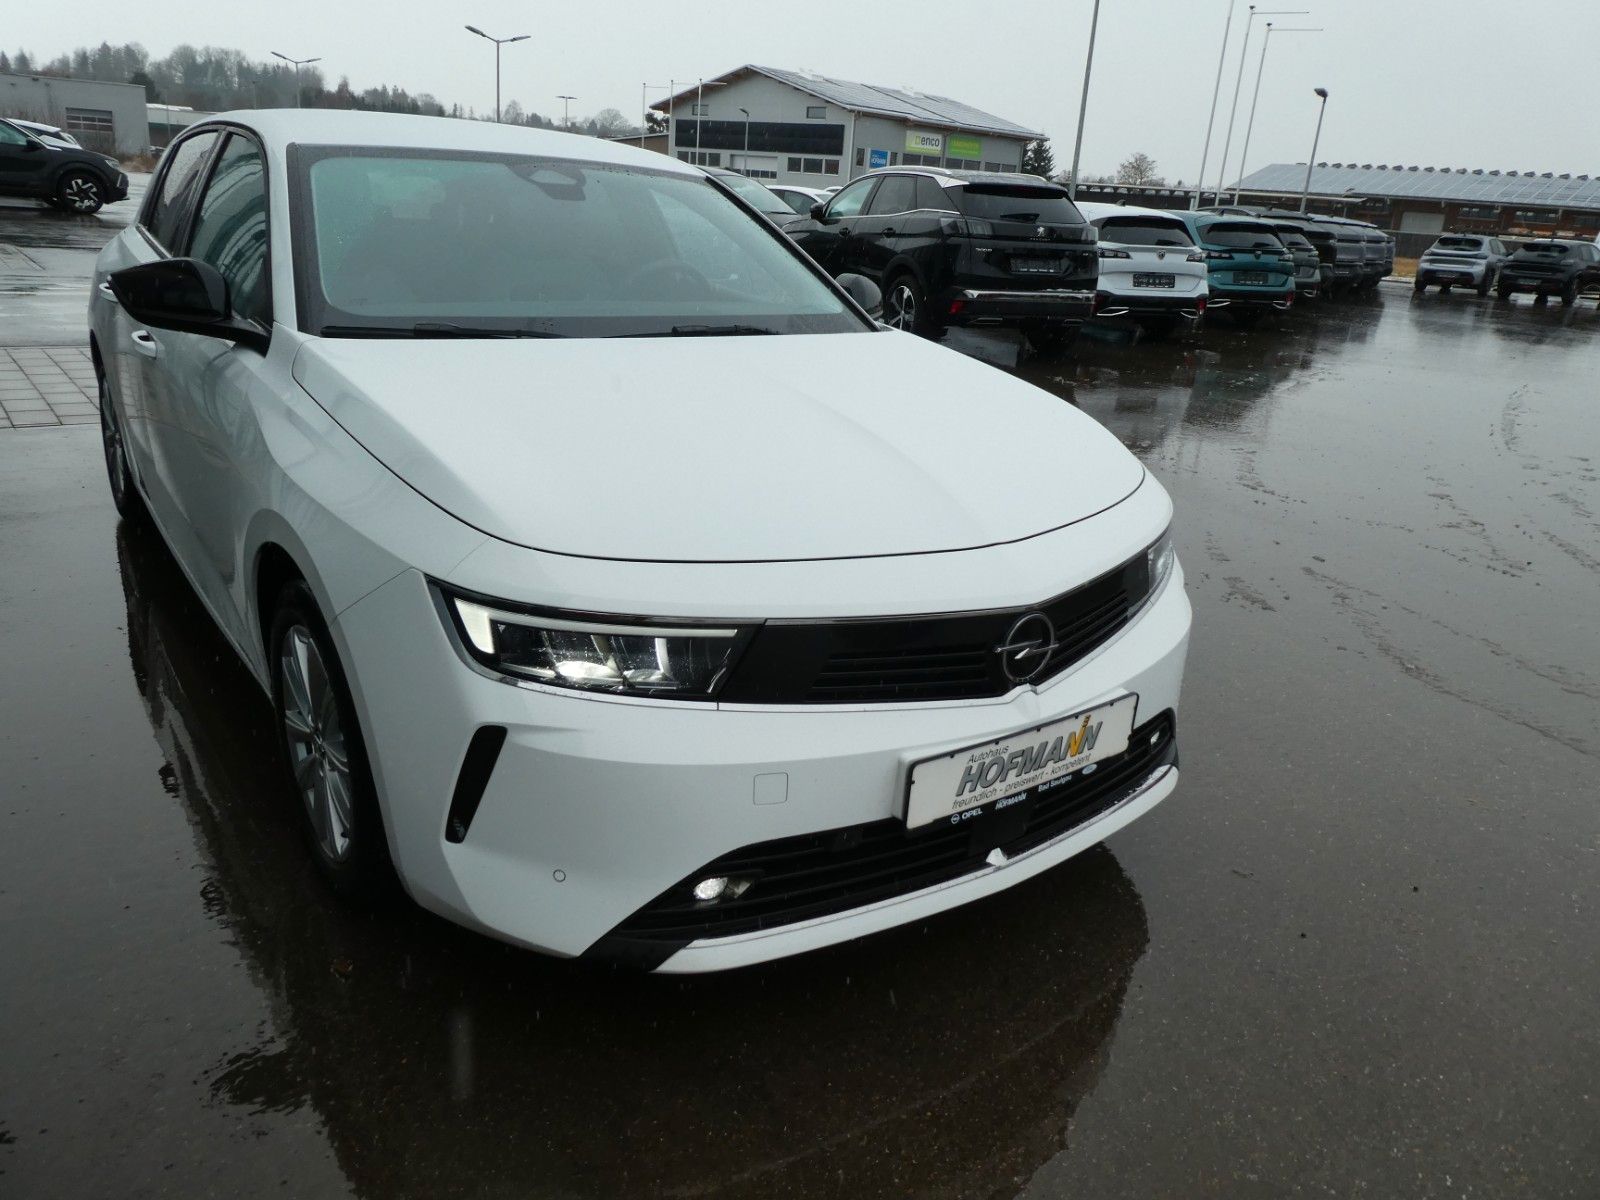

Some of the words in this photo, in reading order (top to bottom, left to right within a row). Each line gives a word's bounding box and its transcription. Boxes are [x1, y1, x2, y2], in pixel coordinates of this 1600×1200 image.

[920, 136, 940, 147] enco
[955, 714, 1103, 797] HOFMANN
[968, 746, 1010, 764] Autohaus
[952, 788, 997, 809] freundlich
[1004, 771, 1045, 795] preiswert
[1050, 753, 1091, 776] kompetent
[961, 807, 983, 820] OPEL
